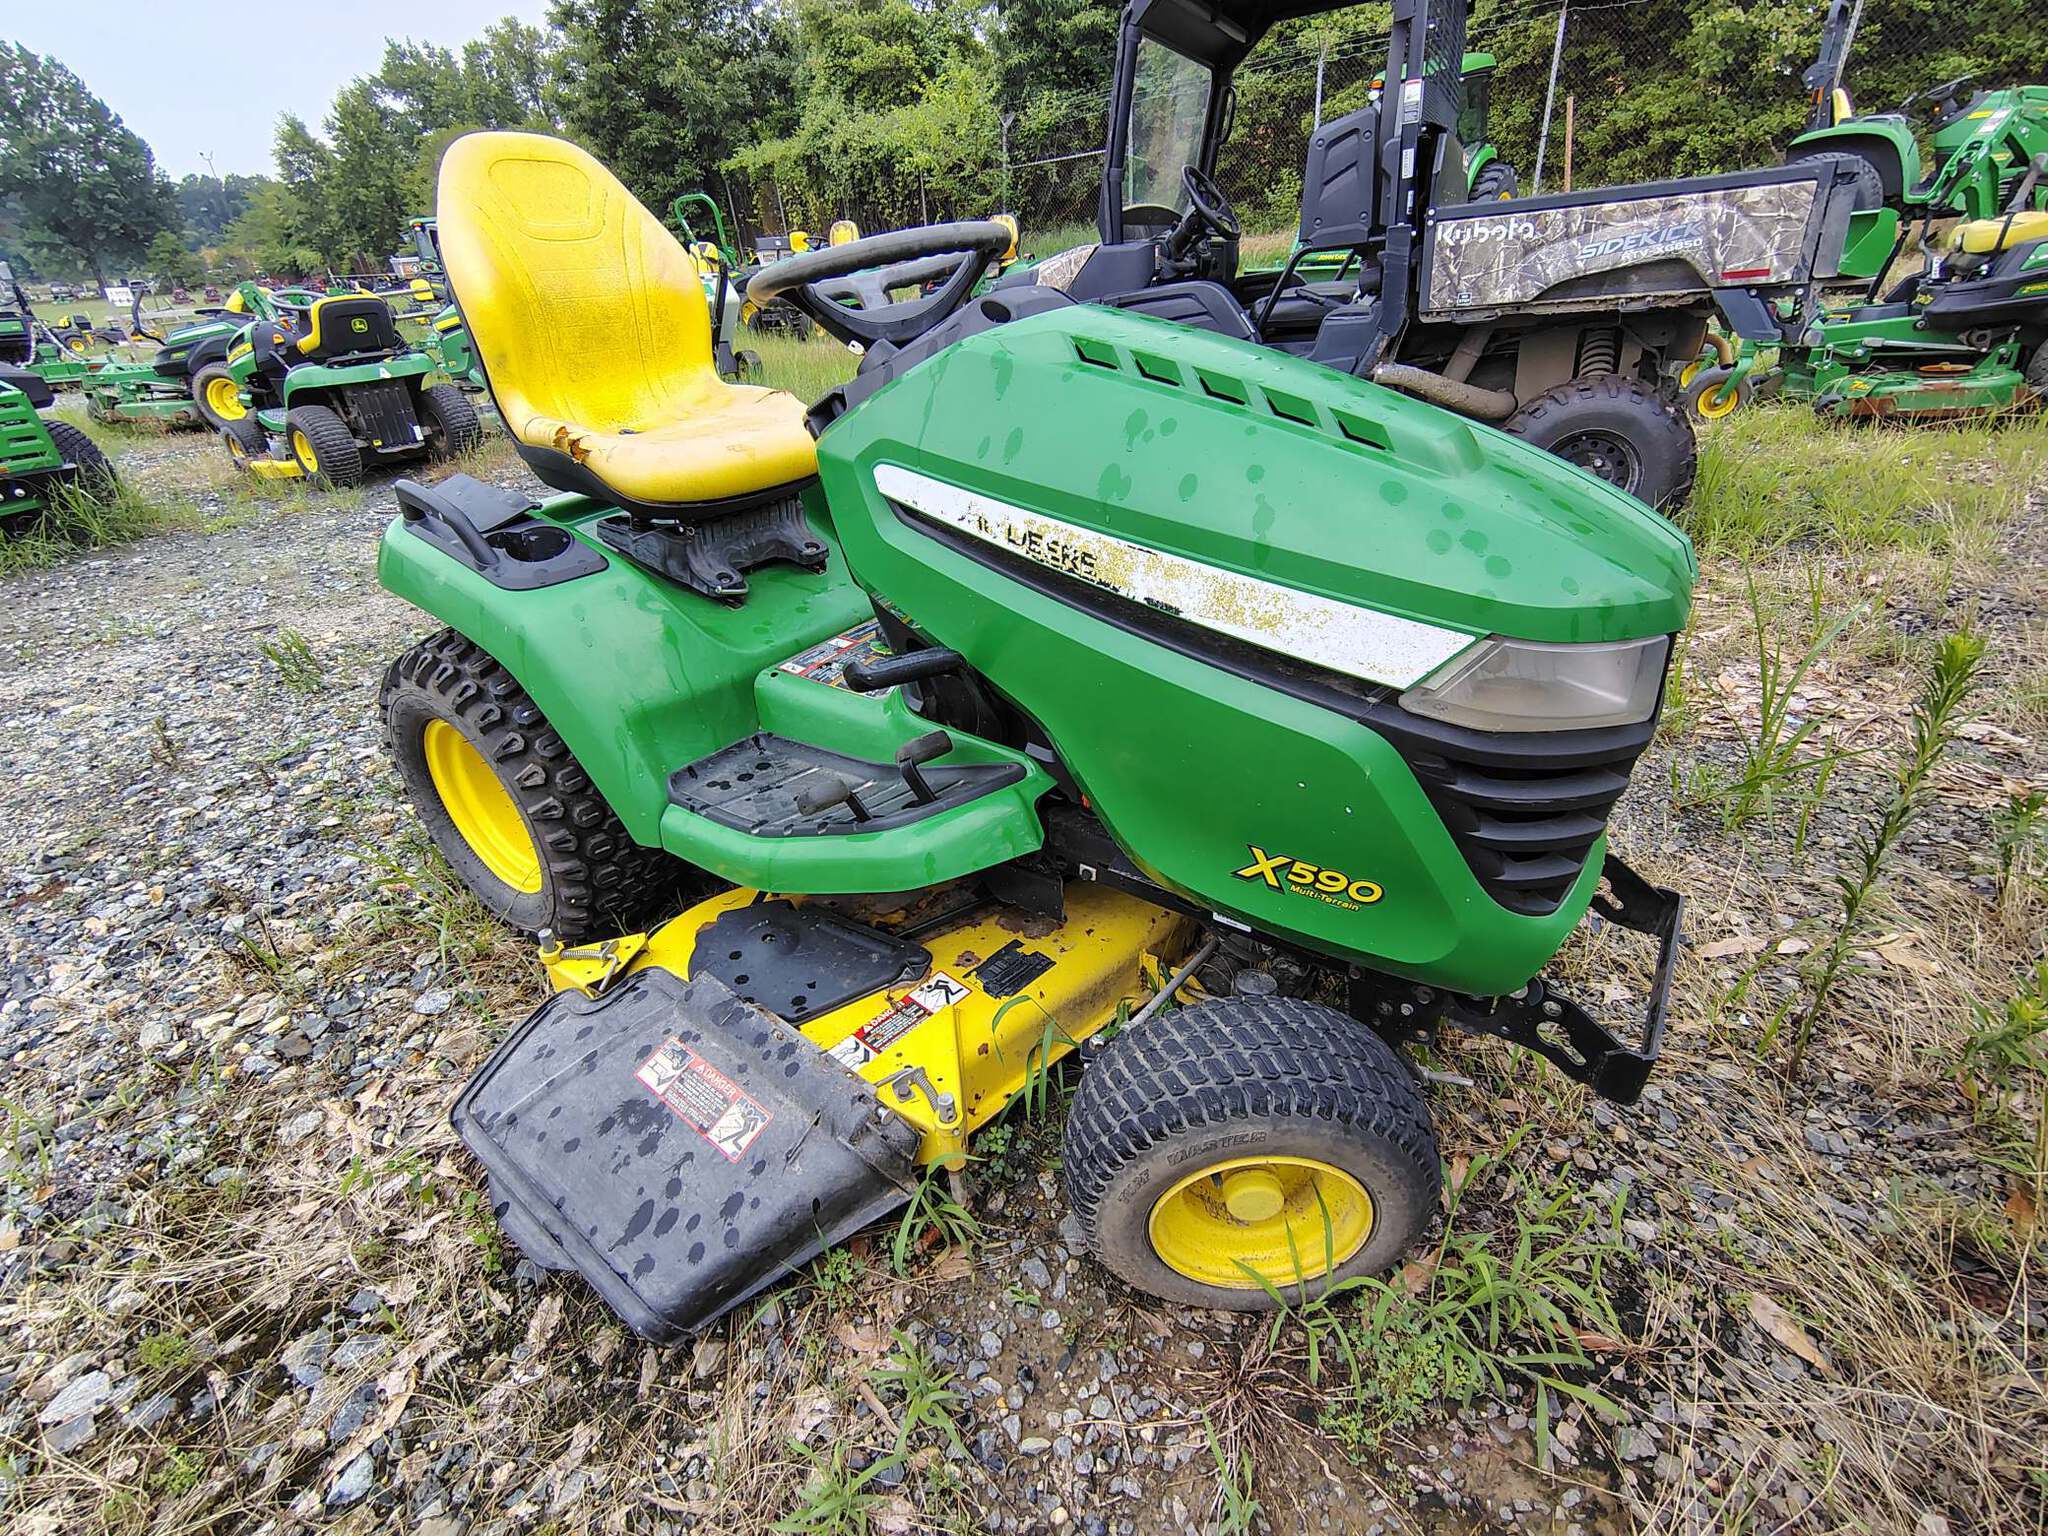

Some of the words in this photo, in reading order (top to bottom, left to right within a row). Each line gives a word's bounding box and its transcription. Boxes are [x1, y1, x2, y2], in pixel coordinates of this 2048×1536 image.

[1437, 217, 1535, 246] Kubota
[1577, 221, 1703, 259] SIDEKICK
[1231, 845, 1386, 904] X590
[1290, 884, 1360, 912] Multi-Terrain
[703, 1068, 737, 1096] DANGER
